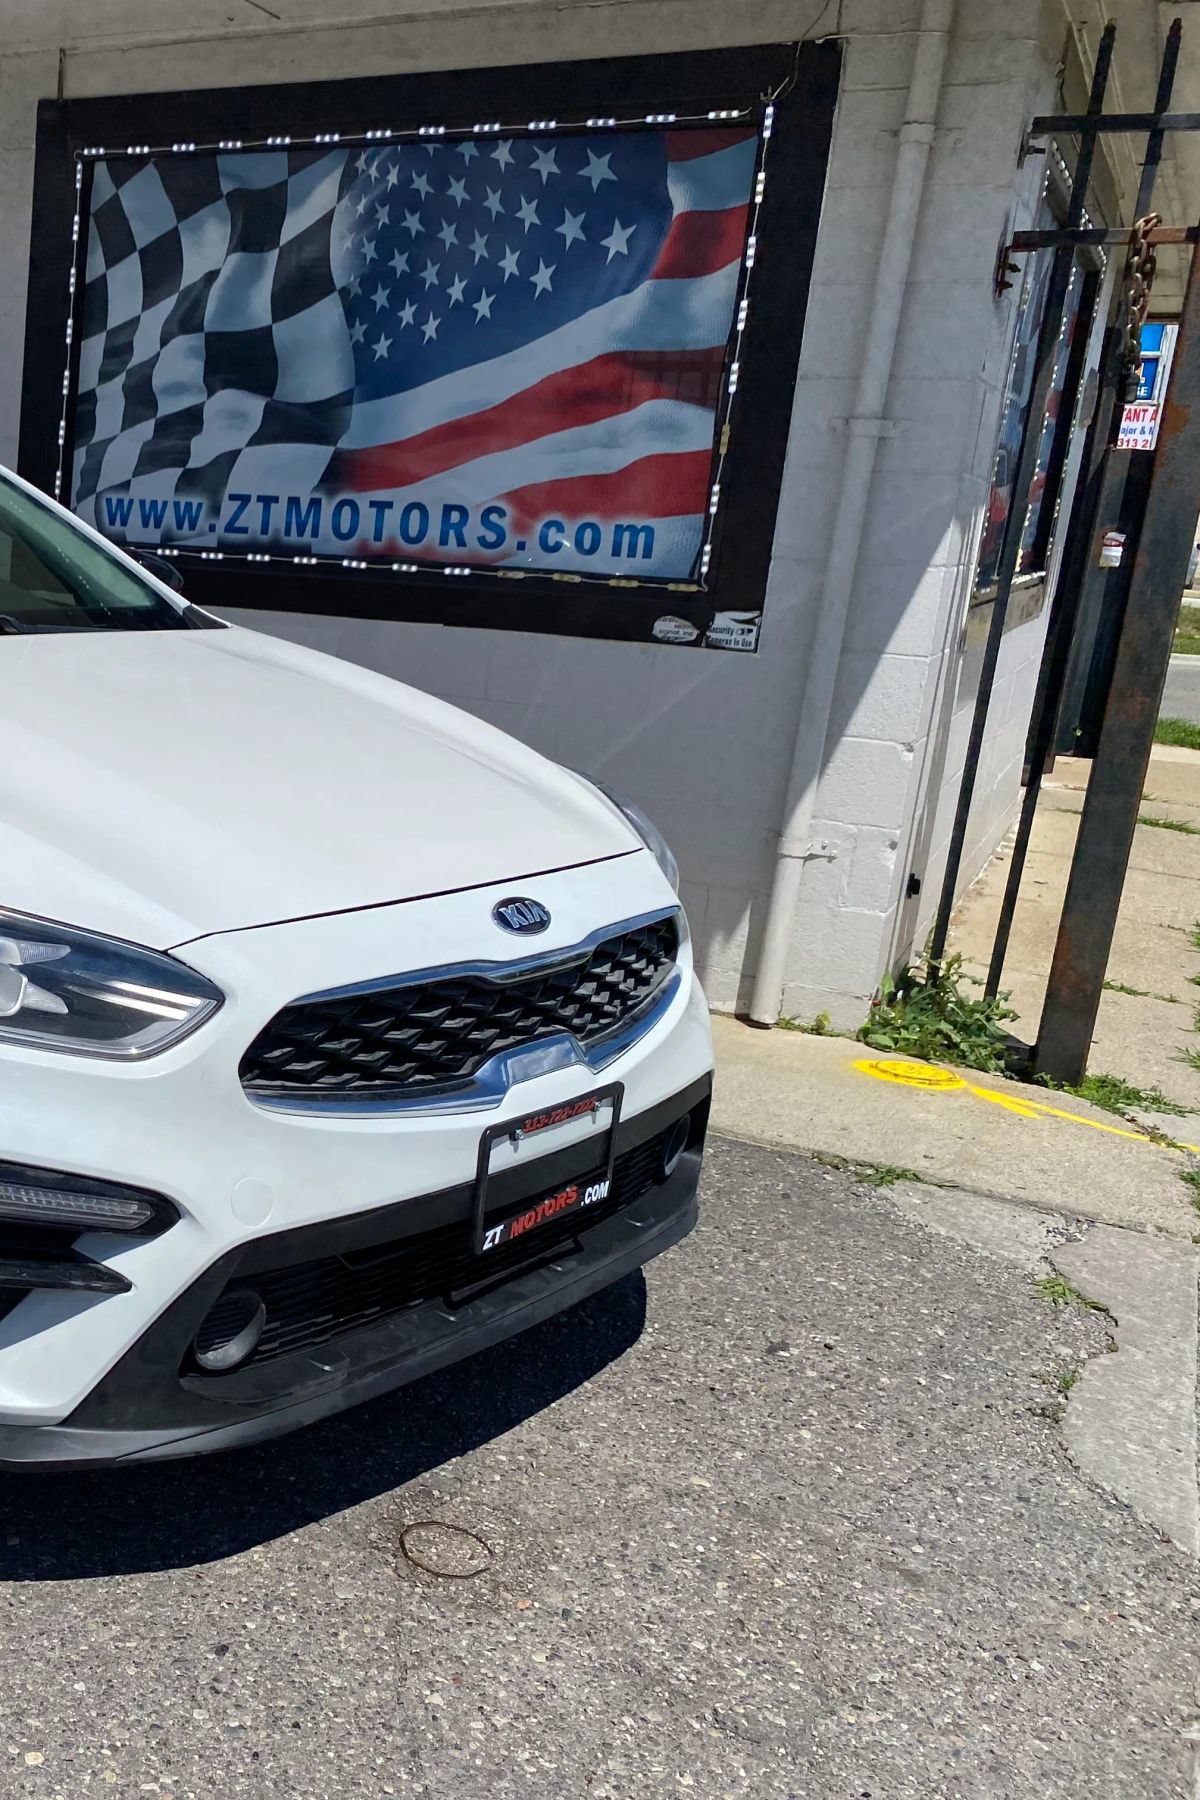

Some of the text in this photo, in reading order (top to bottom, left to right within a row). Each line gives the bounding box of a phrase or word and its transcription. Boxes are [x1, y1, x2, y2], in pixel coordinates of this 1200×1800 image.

[1124, 408, 1149, 422] ANT
[1117, 438, 1138, 448] 313
[105, 492, 656, 560] www.ZTMOTORS.com
[498, 900, 548, 928] KIA
[482, 1224, 504, 1250] ZT
[510, 1185, 579, 1239] MOTORS
